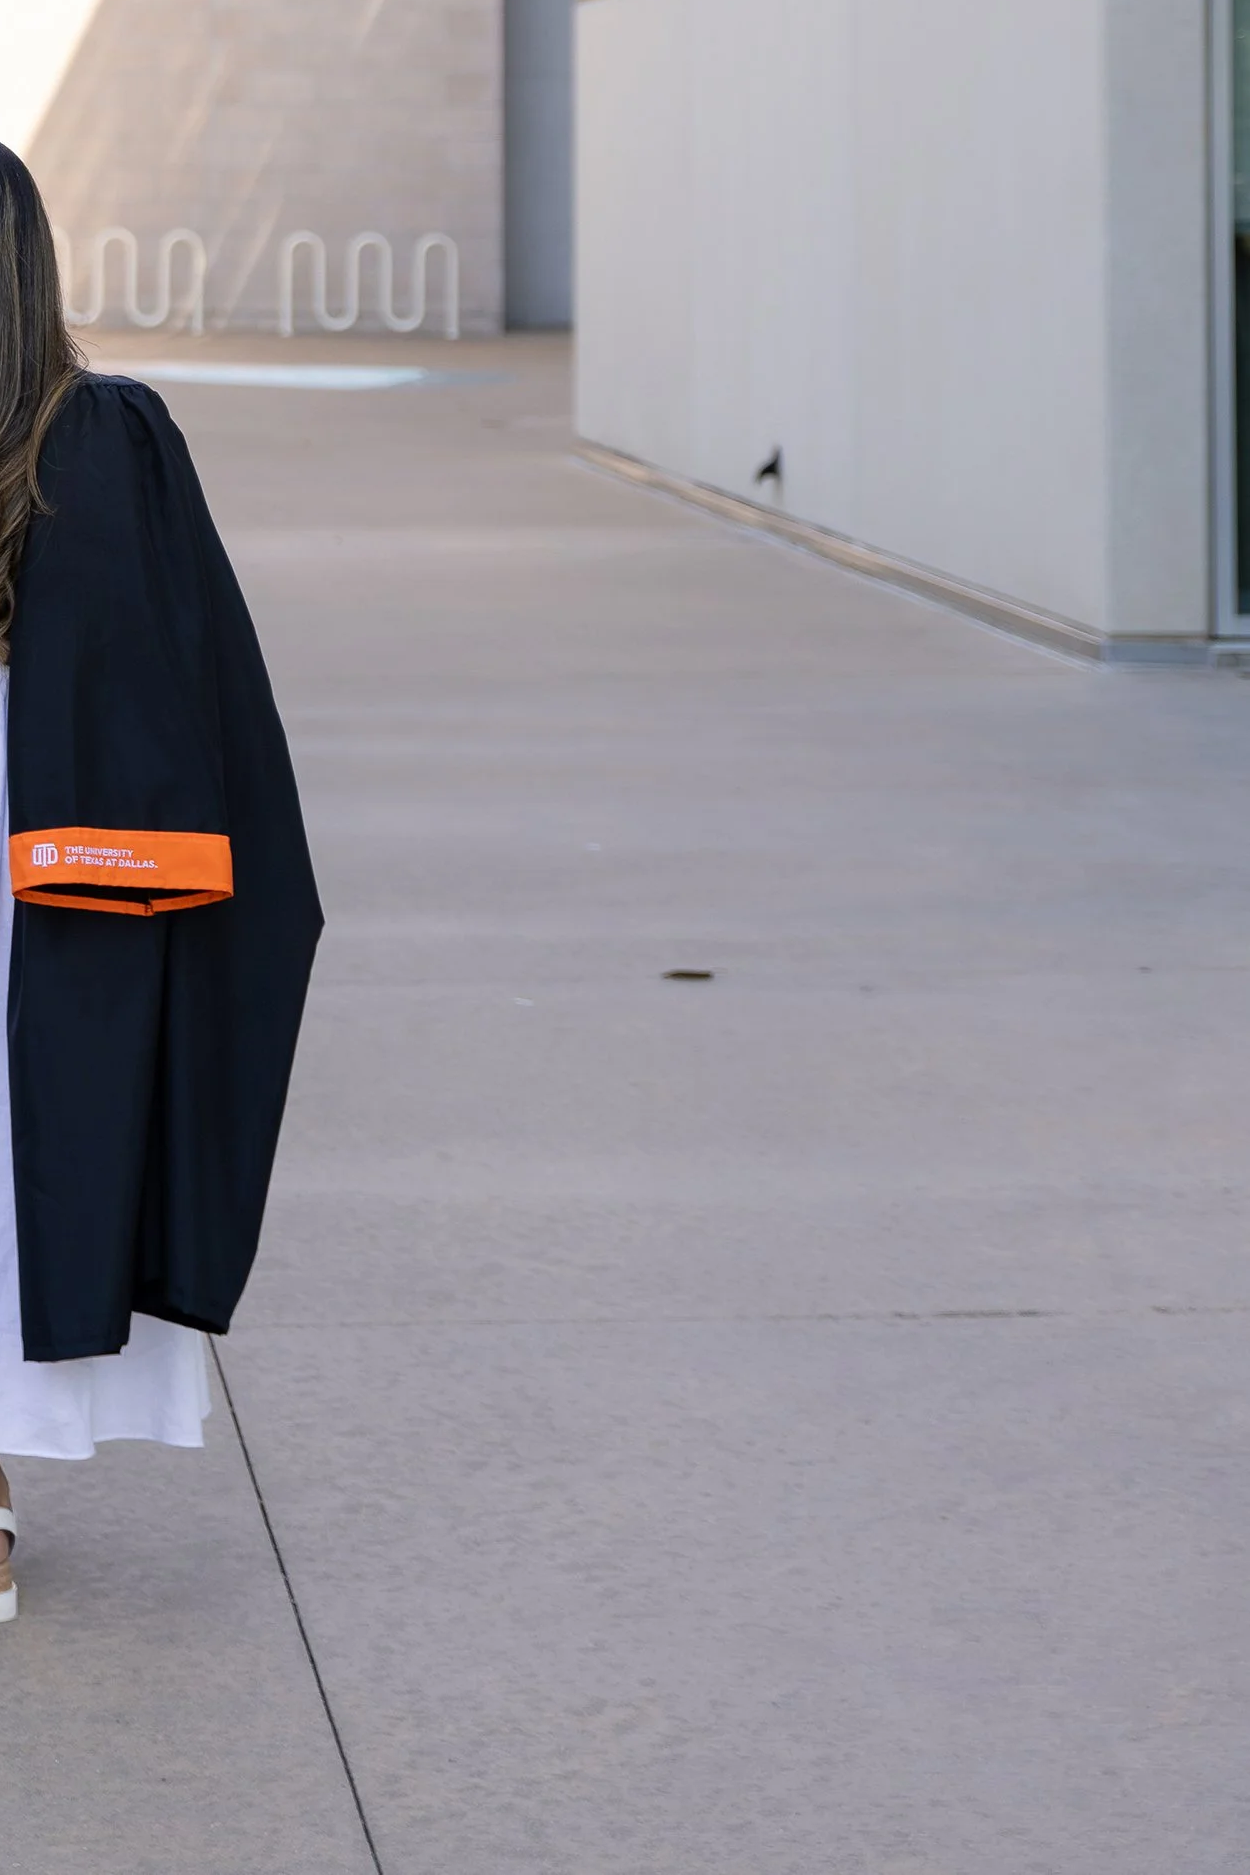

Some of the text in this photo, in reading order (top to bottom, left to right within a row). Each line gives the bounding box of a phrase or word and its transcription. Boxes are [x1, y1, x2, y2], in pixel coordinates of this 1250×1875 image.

[32, 843, 59, 868] UTD
[64, 845, 134, 858] THE UNIVERSITY
[64, 855, 79, 865] OF
[80, 855, 104, 866] TEXAS
[105, 858, 118, 867] AT
